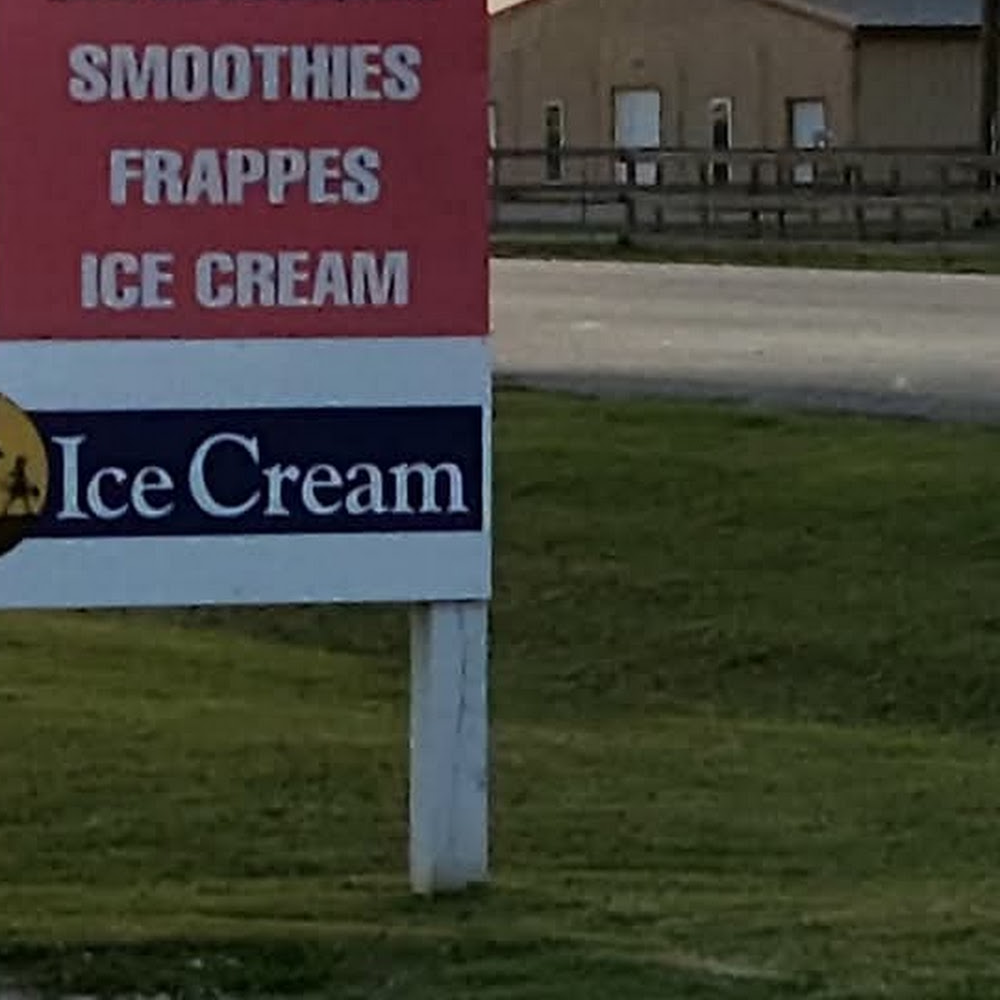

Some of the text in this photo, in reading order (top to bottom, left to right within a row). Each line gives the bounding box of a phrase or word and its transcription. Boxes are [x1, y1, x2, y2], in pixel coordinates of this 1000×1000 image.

[67, 44, 422, 103] SMOOTHIES
[109, 146, 382, 206] FRAPPES
[79, 249, 410, 310] ICE CREAM
[52, 434, 176, 519] Ice
[188, 432, 470, 518] Cream
